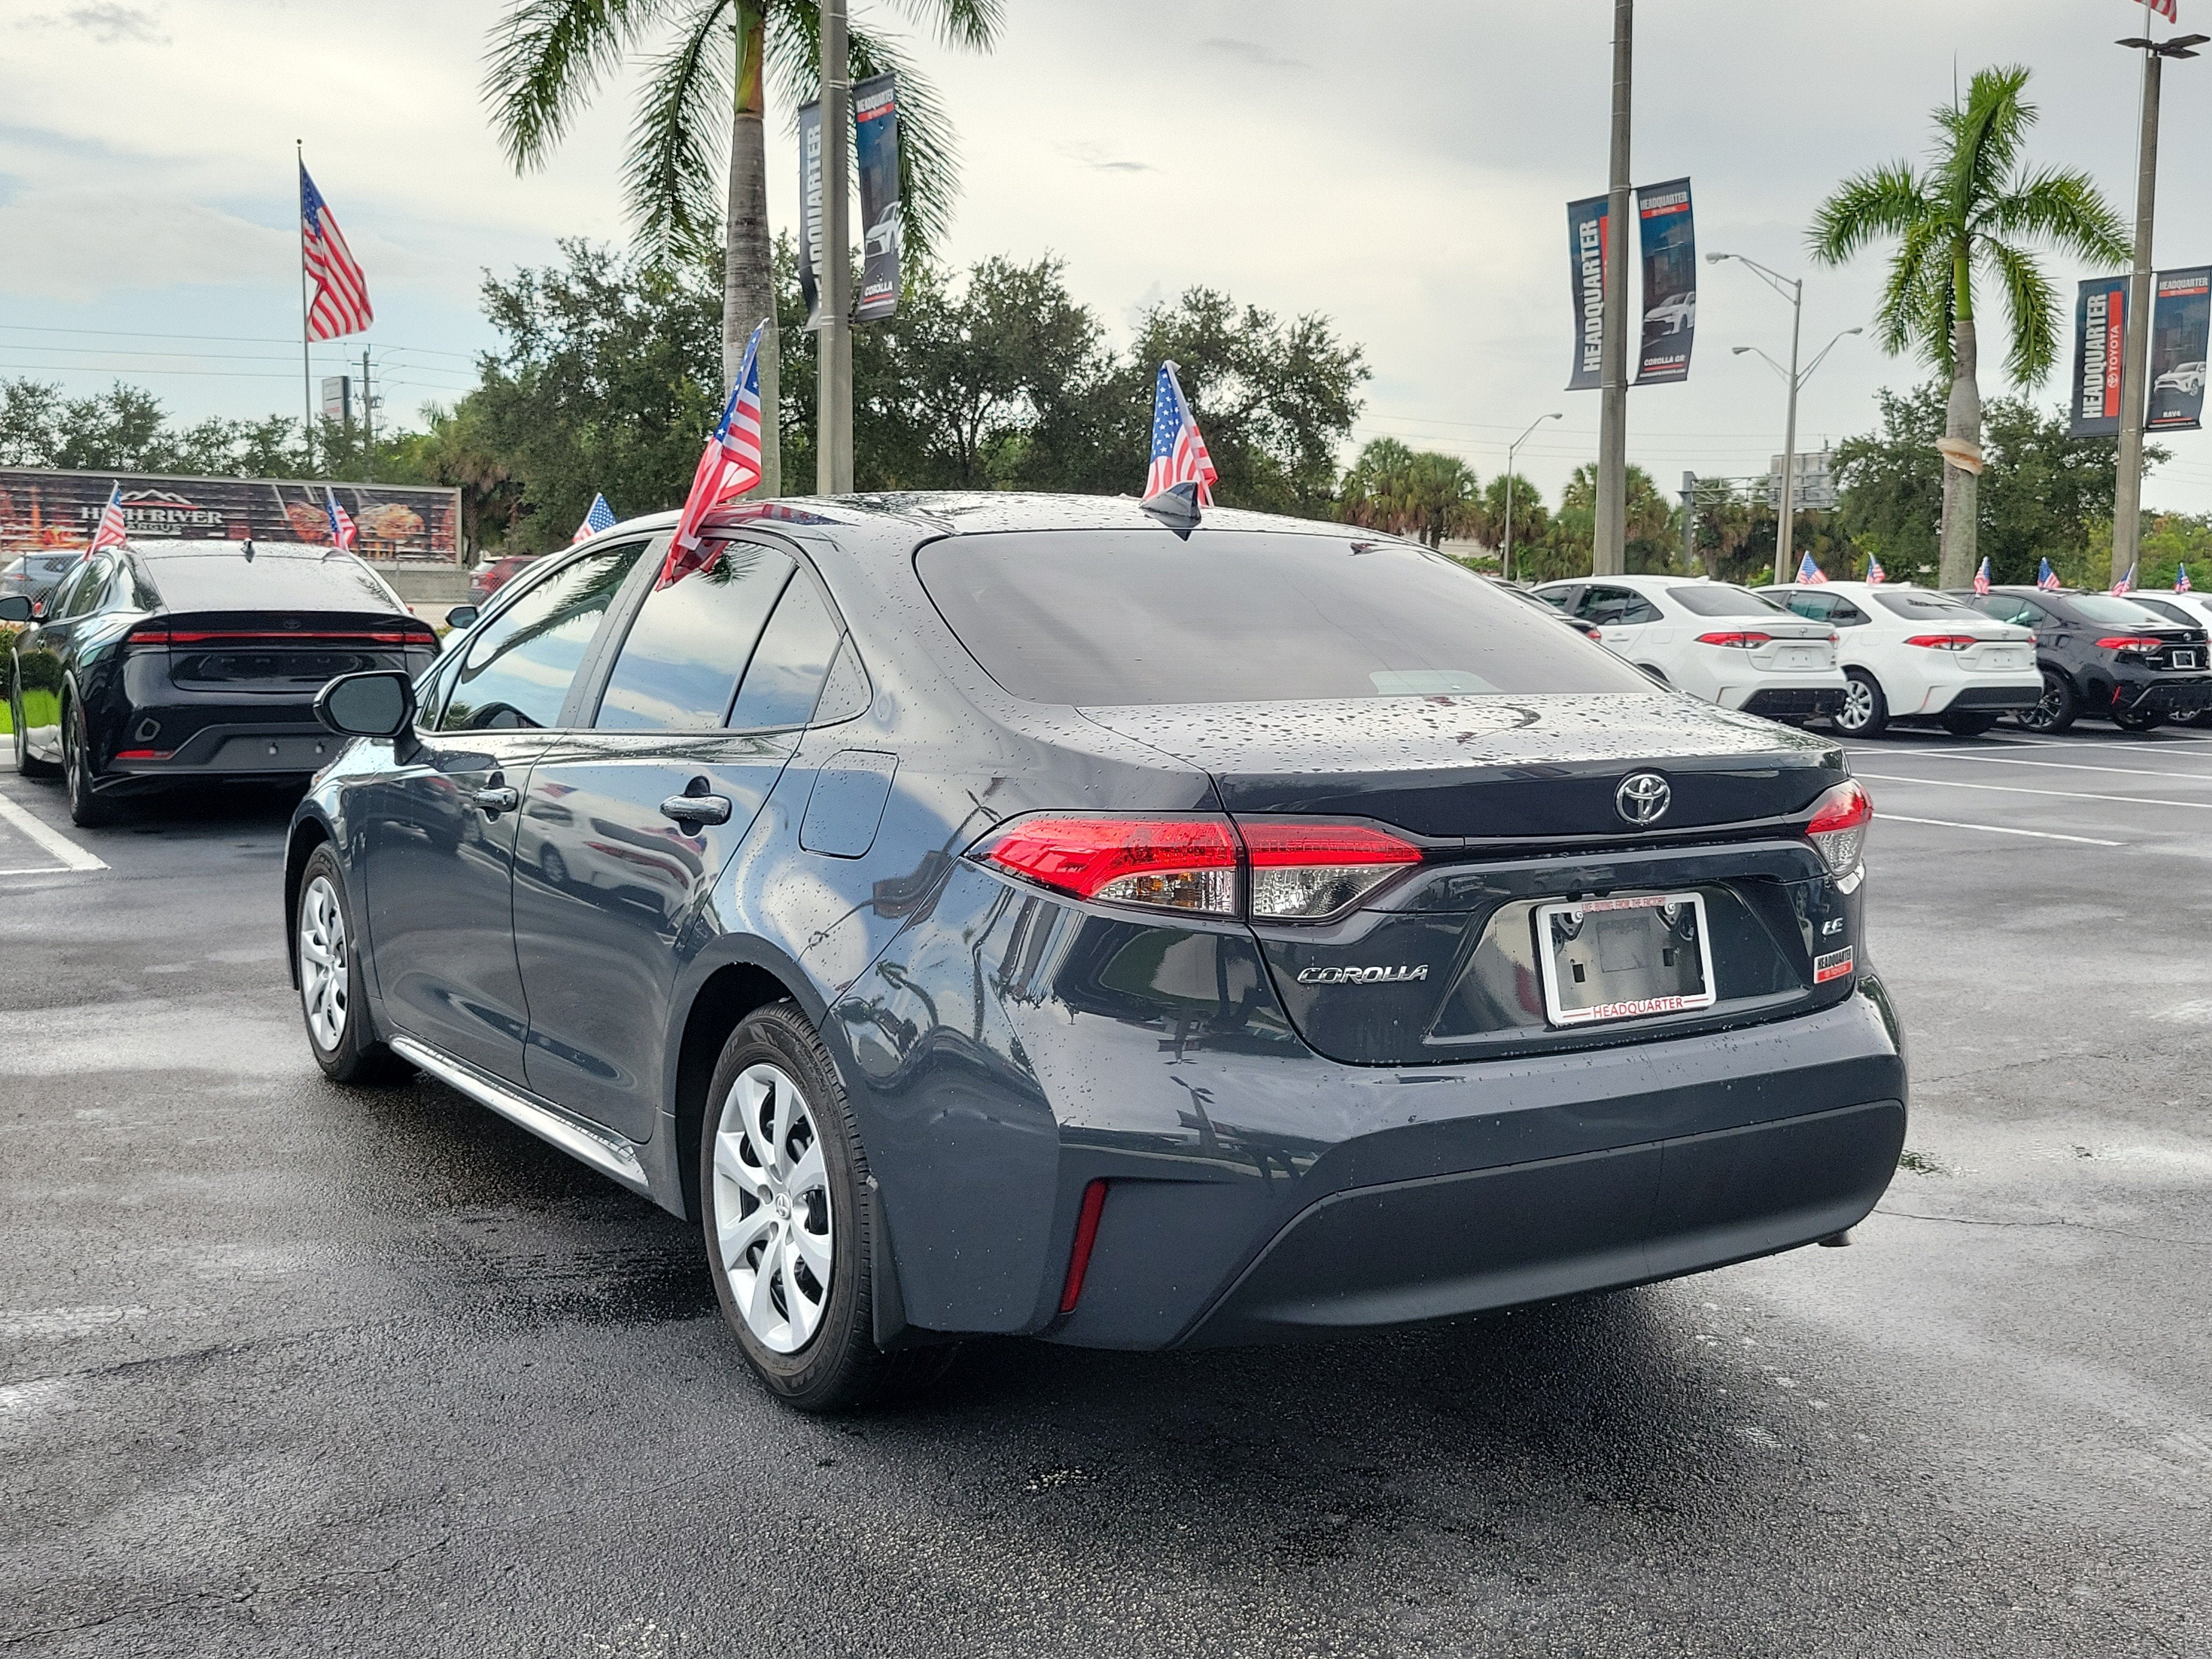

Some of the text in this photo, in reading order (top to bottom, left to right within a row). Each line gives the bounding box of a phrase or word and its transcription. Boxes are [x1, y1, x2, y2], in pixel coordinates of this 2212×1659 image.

[2159, 277, 2208, 290] HEADQUARTER
[1579, 219, 1604, 372] HEADQUARTER
[2082, 294, 2107, 419] HEADQUARTER
[2109, 324, 2120, 372] TOYOTA
[1644, 355, 1674, 366] COROLLA
[150, 509, 224, 524] RIVER
[1818, 949, 1851, 970] HEADQUARTER
[1297, 964, 1429, 985] COROLLA
[1593, 997, 1683, 1018] HEADQUARTER
